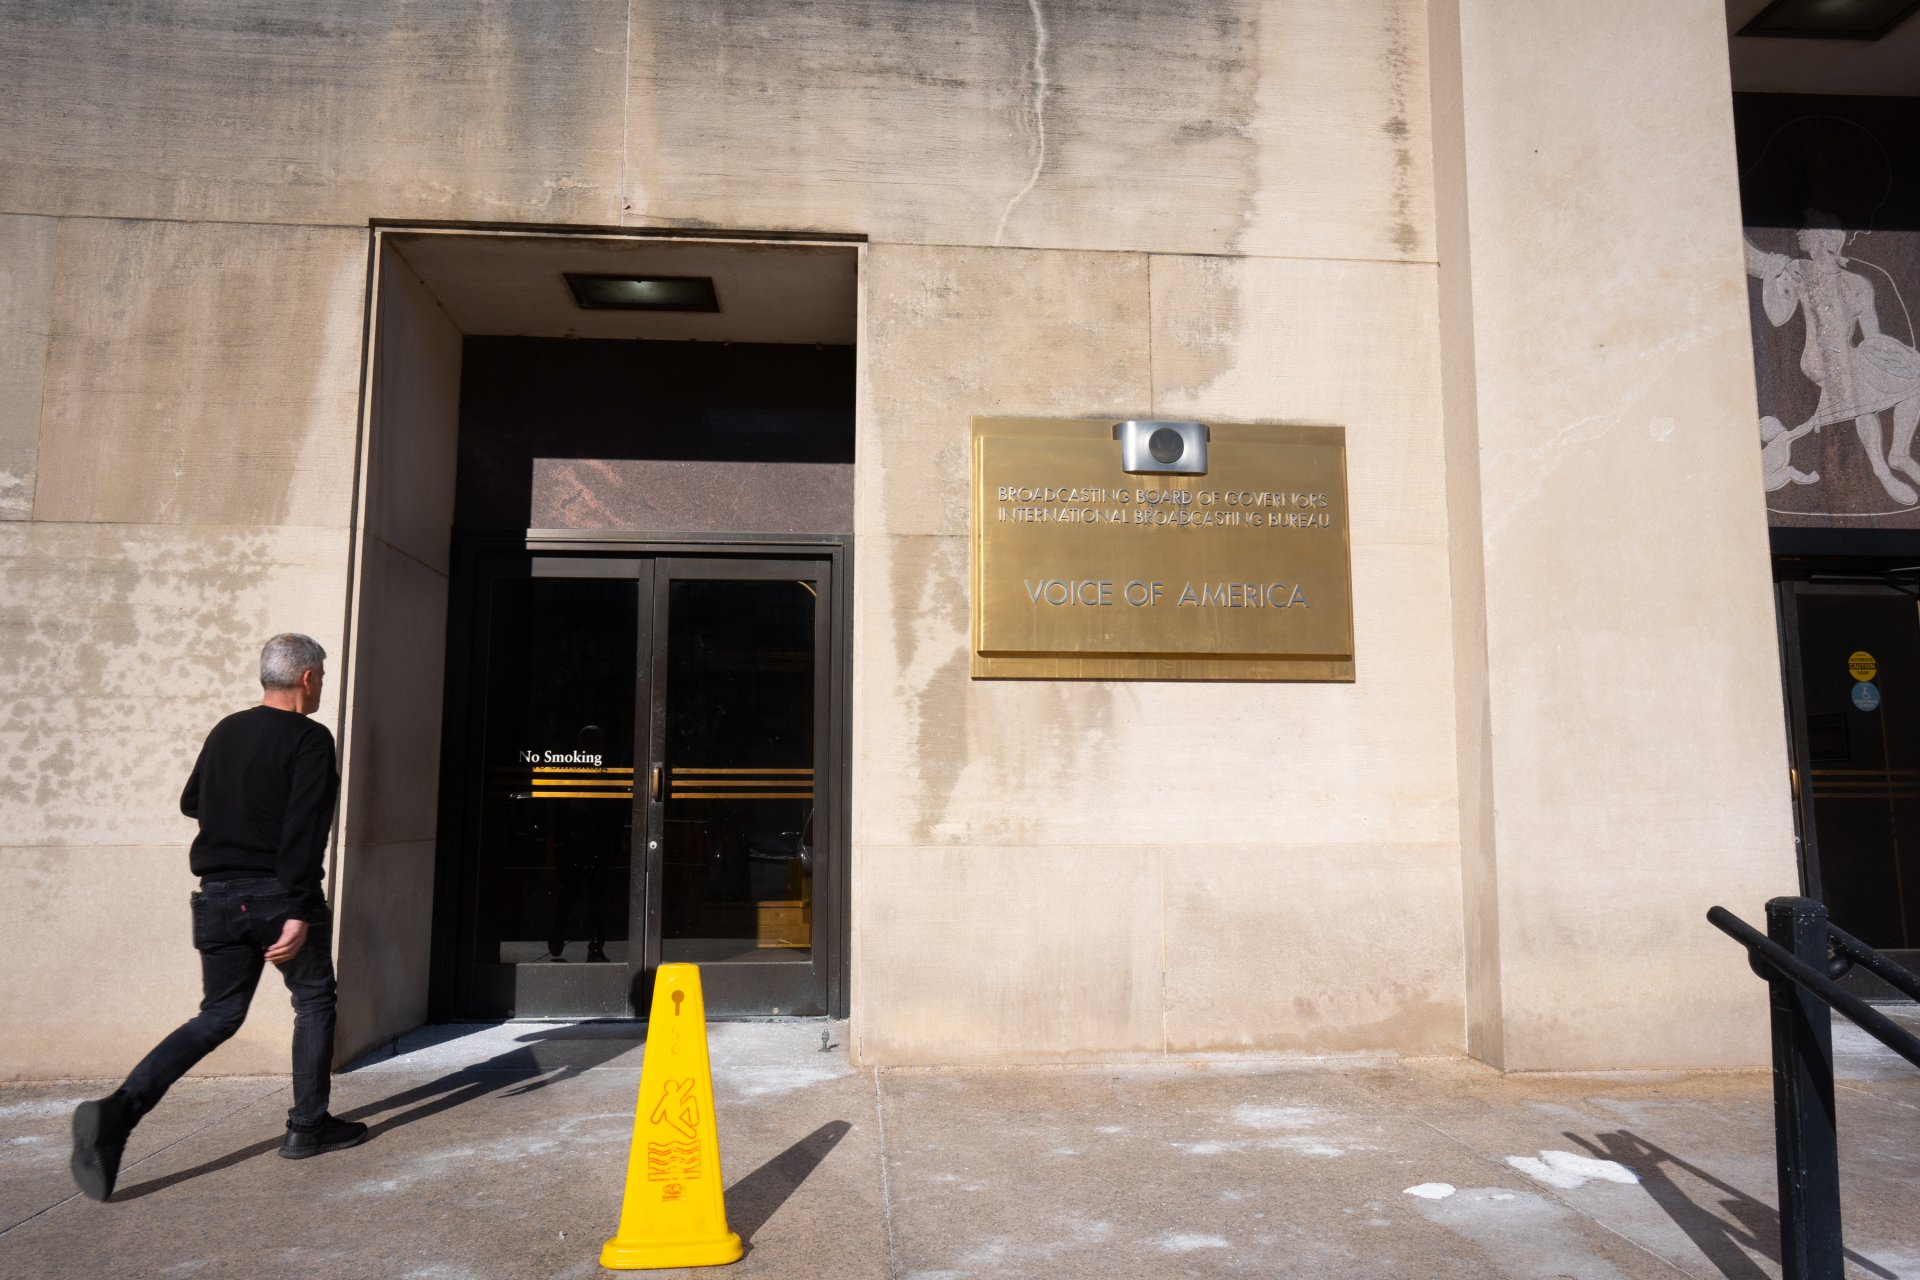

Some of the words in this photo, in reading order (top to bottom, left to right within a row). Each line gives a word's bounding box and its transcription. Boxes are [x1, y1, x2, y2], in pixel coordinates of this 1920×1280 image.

[998, 486, 1130, 504] BROADCASTING
[1136, 489, 1192, 505] BOARD
[1198, 491, 1220, 506] OF
[1225, 492, 1328, 508] GOVERNORS
[998, 507, 1129, 524] INTERNATIONAL
[1134, 509, 1263, 527] BROADCASTING
[1268, 512, 1330, 528] BUREAU
[1024, 579, 1112, 606] VOICE
[1124, 580, 1164, 606] OF
[1178, 582, 1309, 609] AMERICA
[519, 750, 540, 763] No
[544, 750, 602, 767] Smoking
